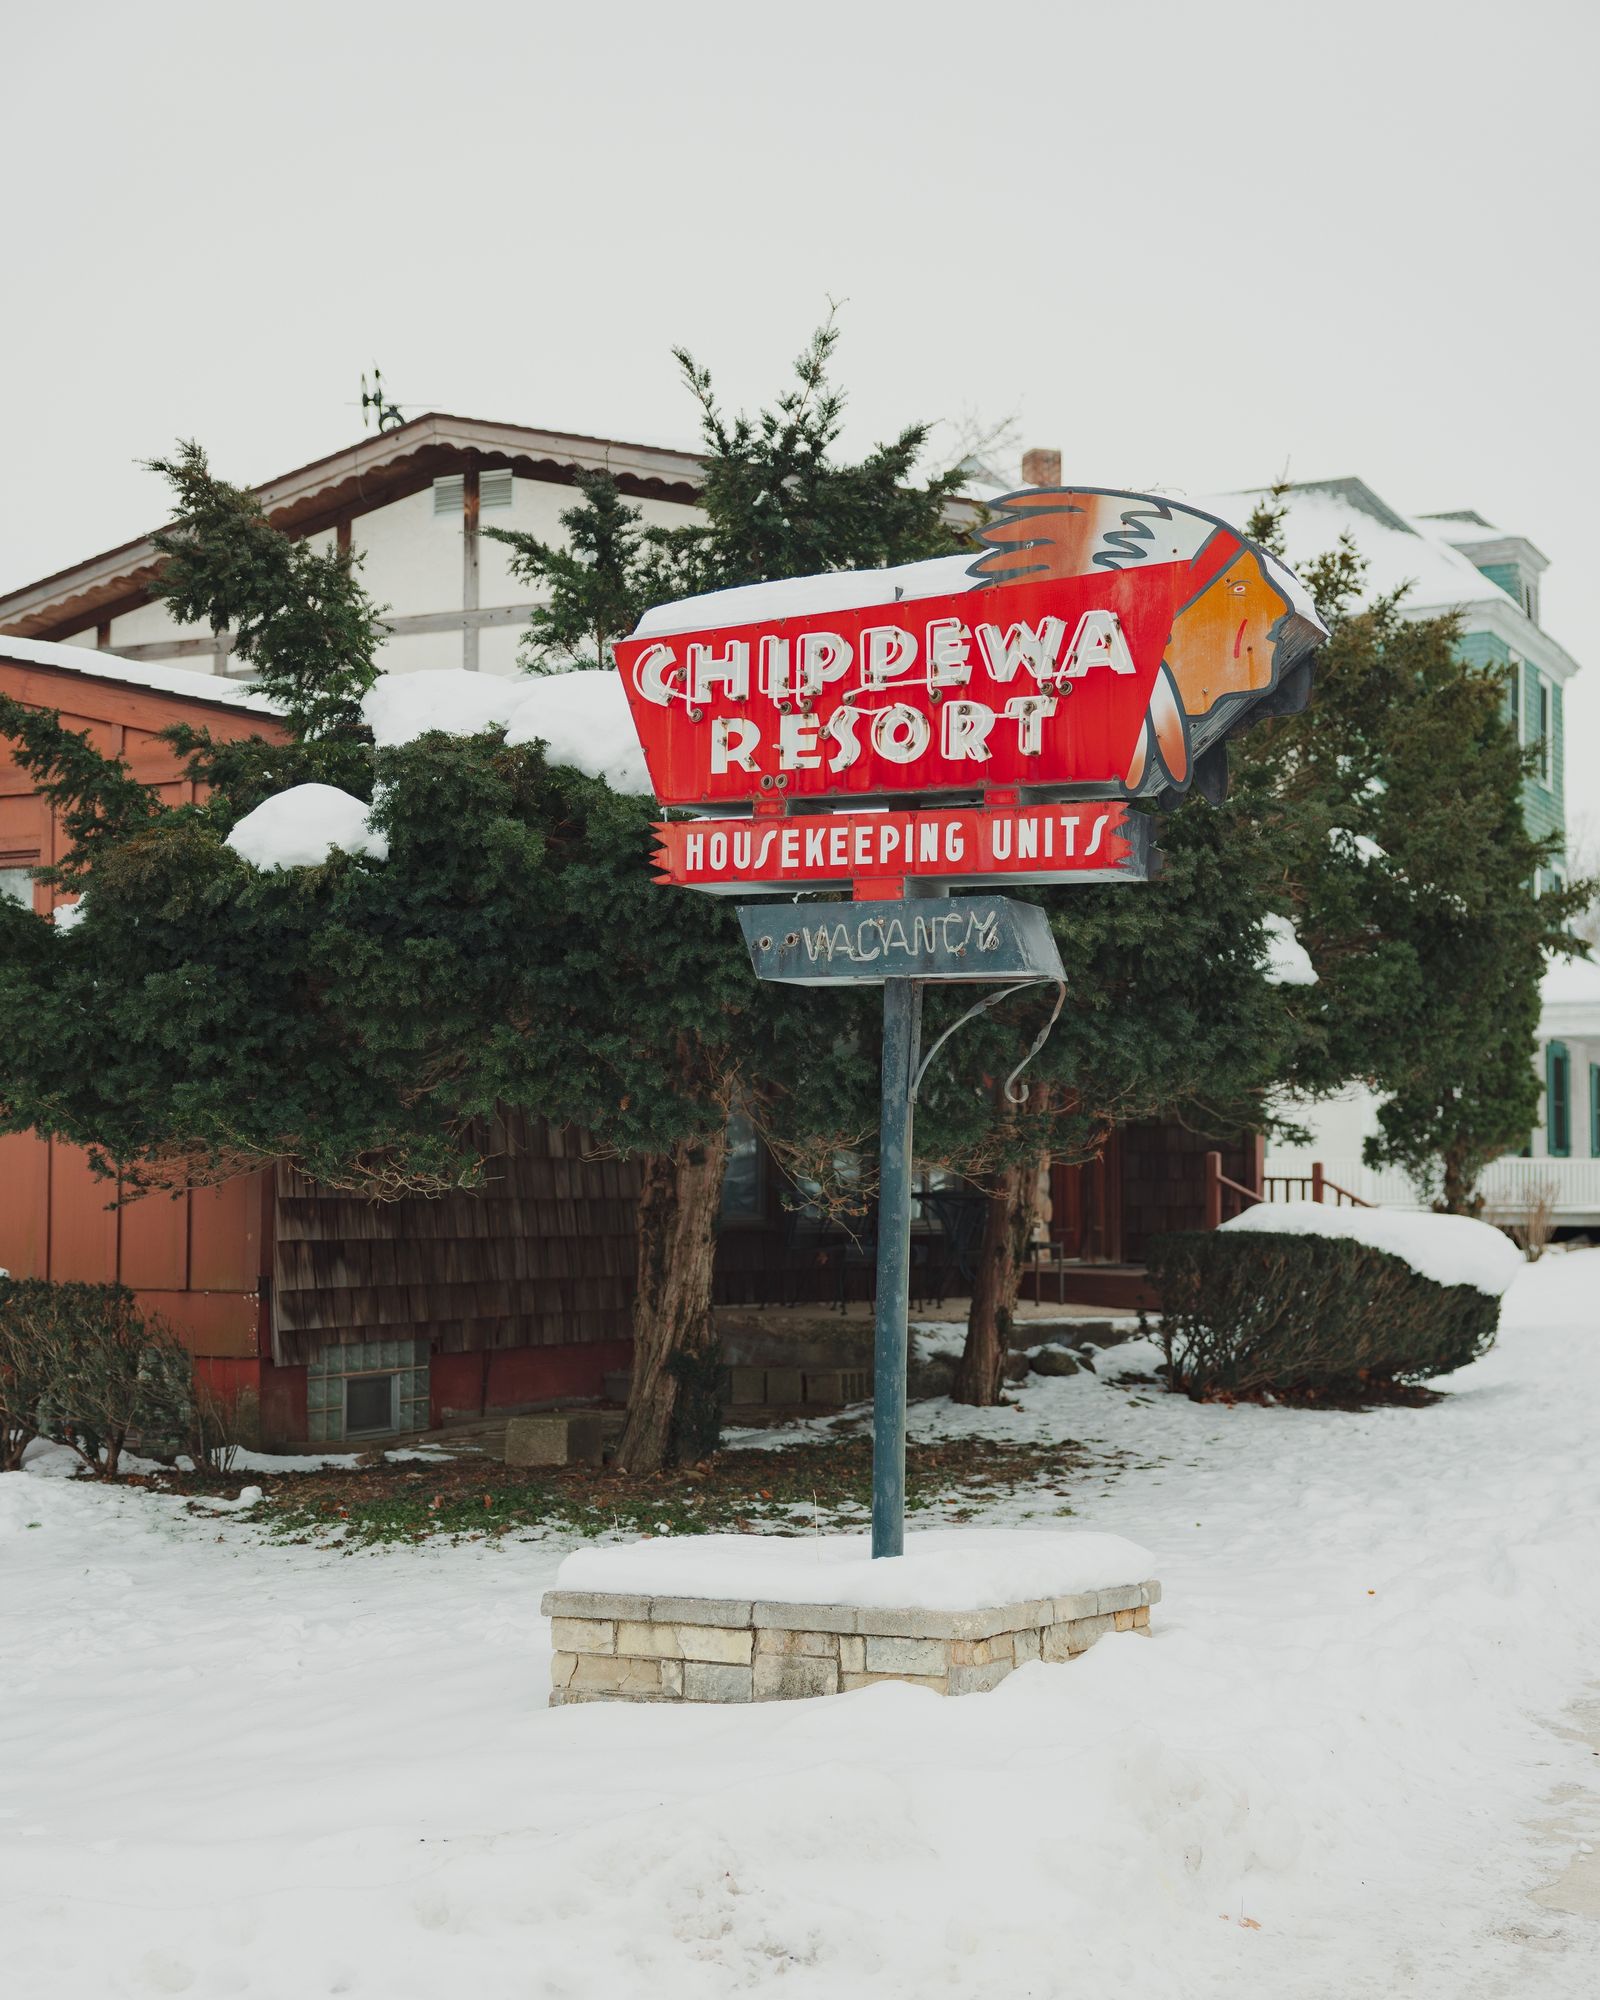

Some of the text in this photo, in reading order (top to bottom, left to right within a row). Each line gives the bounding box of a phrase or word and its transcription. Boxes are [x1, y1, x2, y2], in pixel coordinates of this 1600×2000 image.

[633, 610, 1136, 710] CHIPPEWA
[710, 696, 1058, 775] RESORT
[686, 815, 1109, 871] HOUSEKEEPING UNITS
[802, 910, 999, 962] VACANCY
